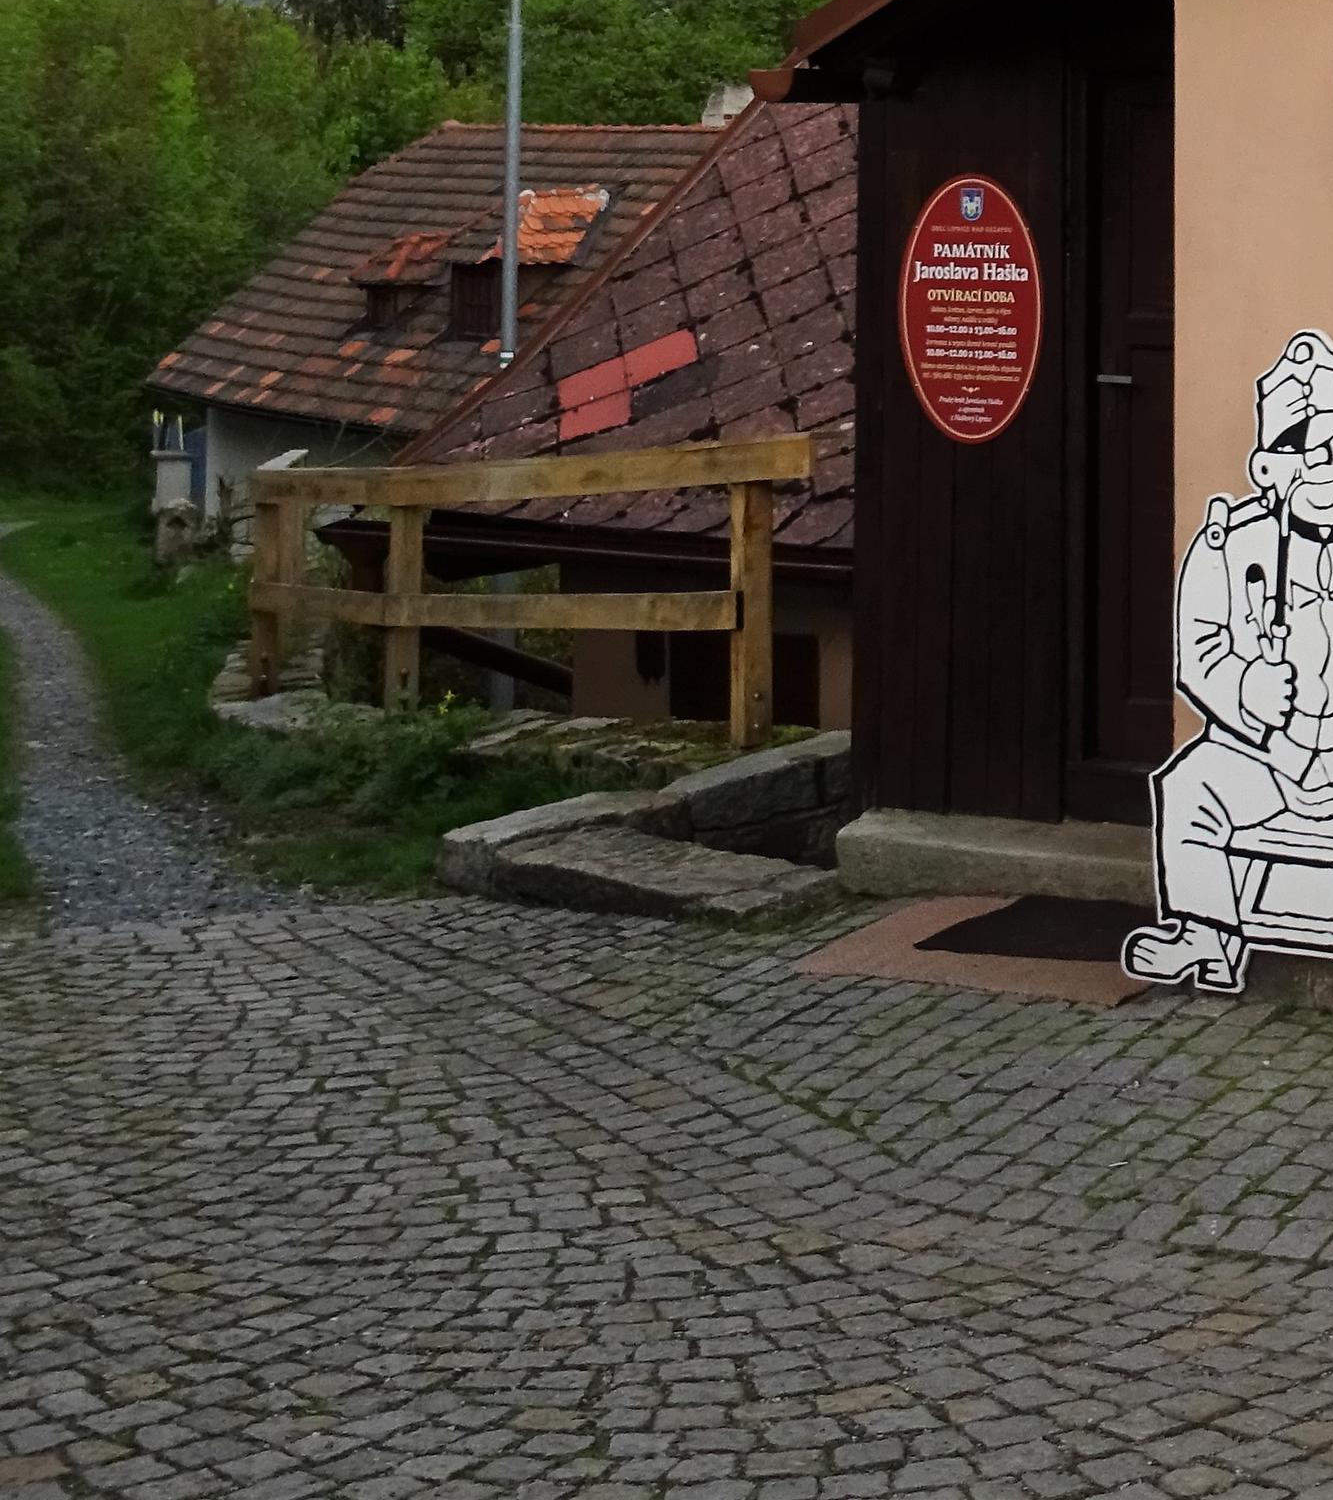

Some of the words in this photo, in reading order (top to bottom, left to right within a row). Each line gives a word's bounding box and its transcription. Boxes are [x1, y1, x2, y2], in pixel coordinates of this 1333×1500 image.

[933, 242, 1010, 259] PAMÁTNÍK
[913, 261, 979, 282] Jaroslava
[983, 263, 1029, 282] Haška
[927, 288, 981, 302] OTVÍRACÍ
[983, 291, 1015, 303] DOBA
